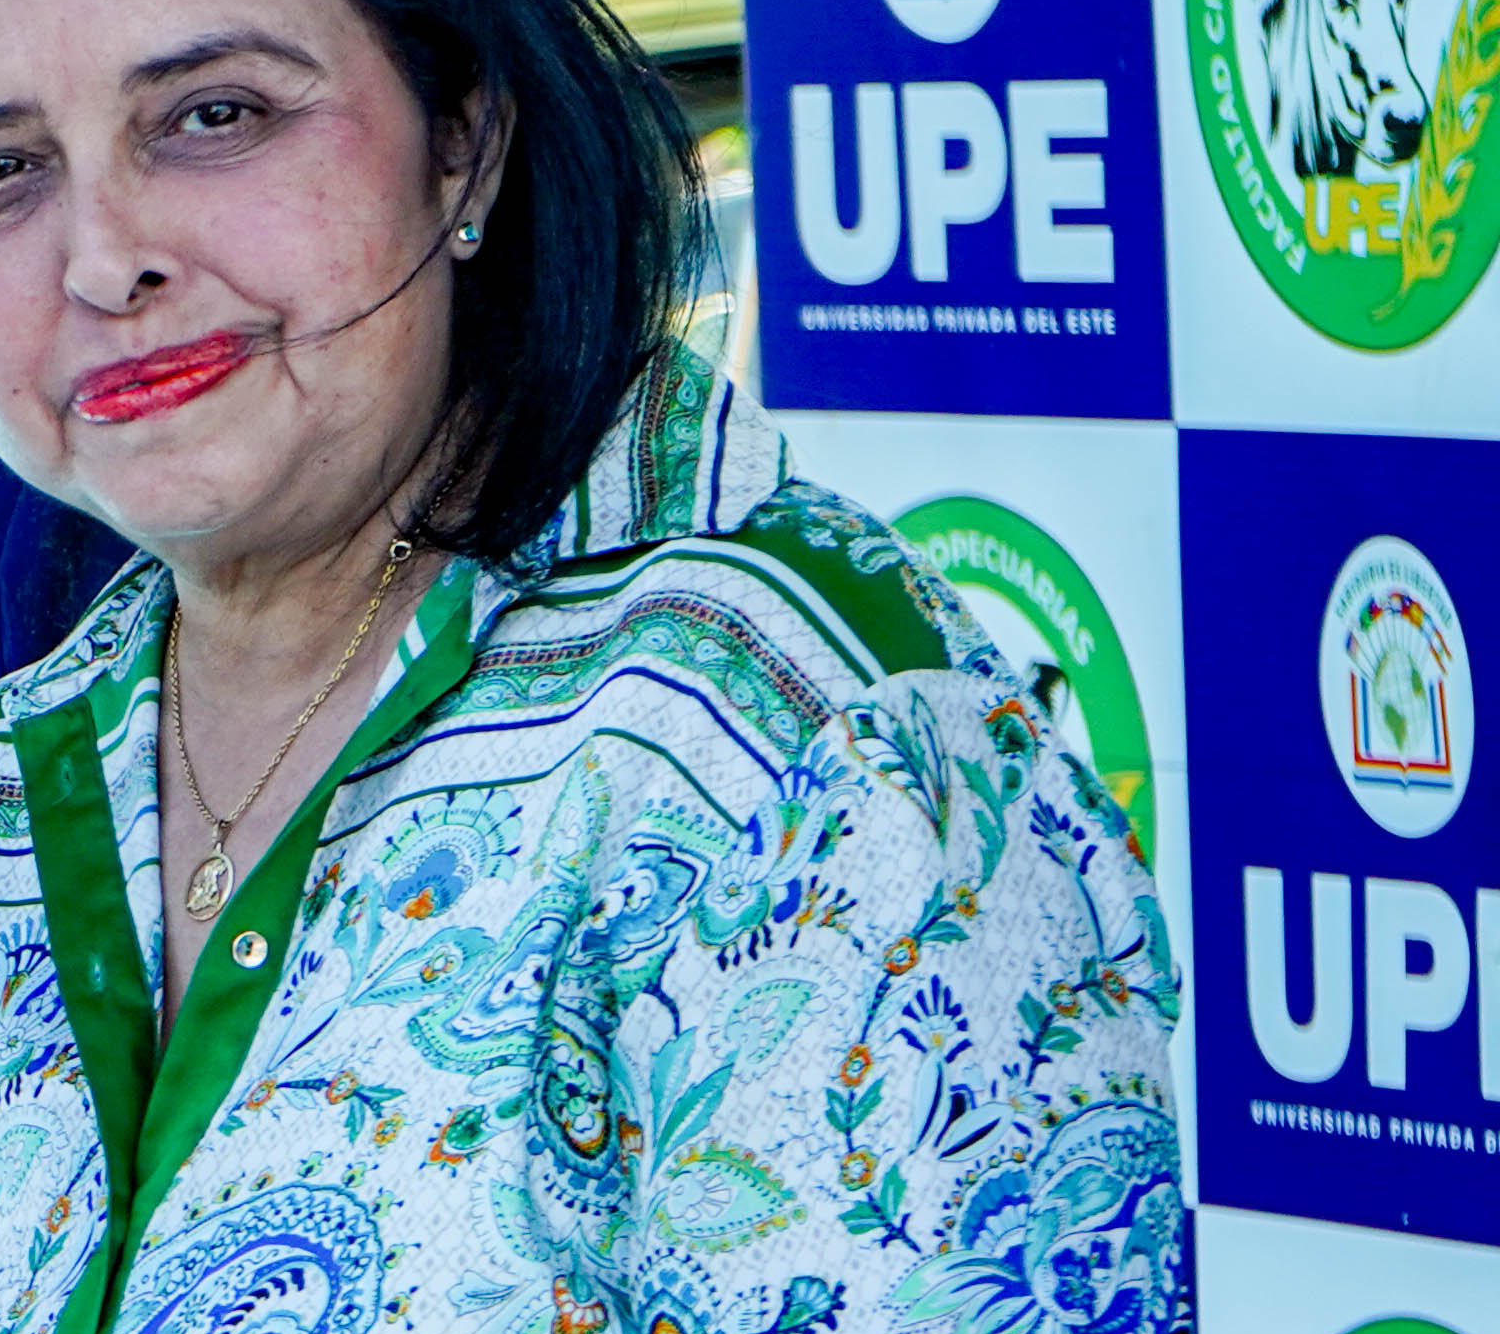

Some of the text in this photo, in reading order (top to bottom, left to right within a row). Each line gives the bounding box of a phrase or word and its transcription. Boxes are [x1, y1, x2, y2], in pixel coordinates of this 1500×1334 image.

[790, 78, 1115, 286] UPE
[1211, 66, 1306, 275] FACULTAD
[1304, 179, 1402, 257] UPE
[800, 304, 1116, 335] UNIVERSIDAD PRIVADA DEL ESTE
[1243, 866, 1500, 1101] UP
[1250, 1099, 1380, 1139] UNIVERSIDAD
[1388, 1117, 1475, 1153] PRIVADA
